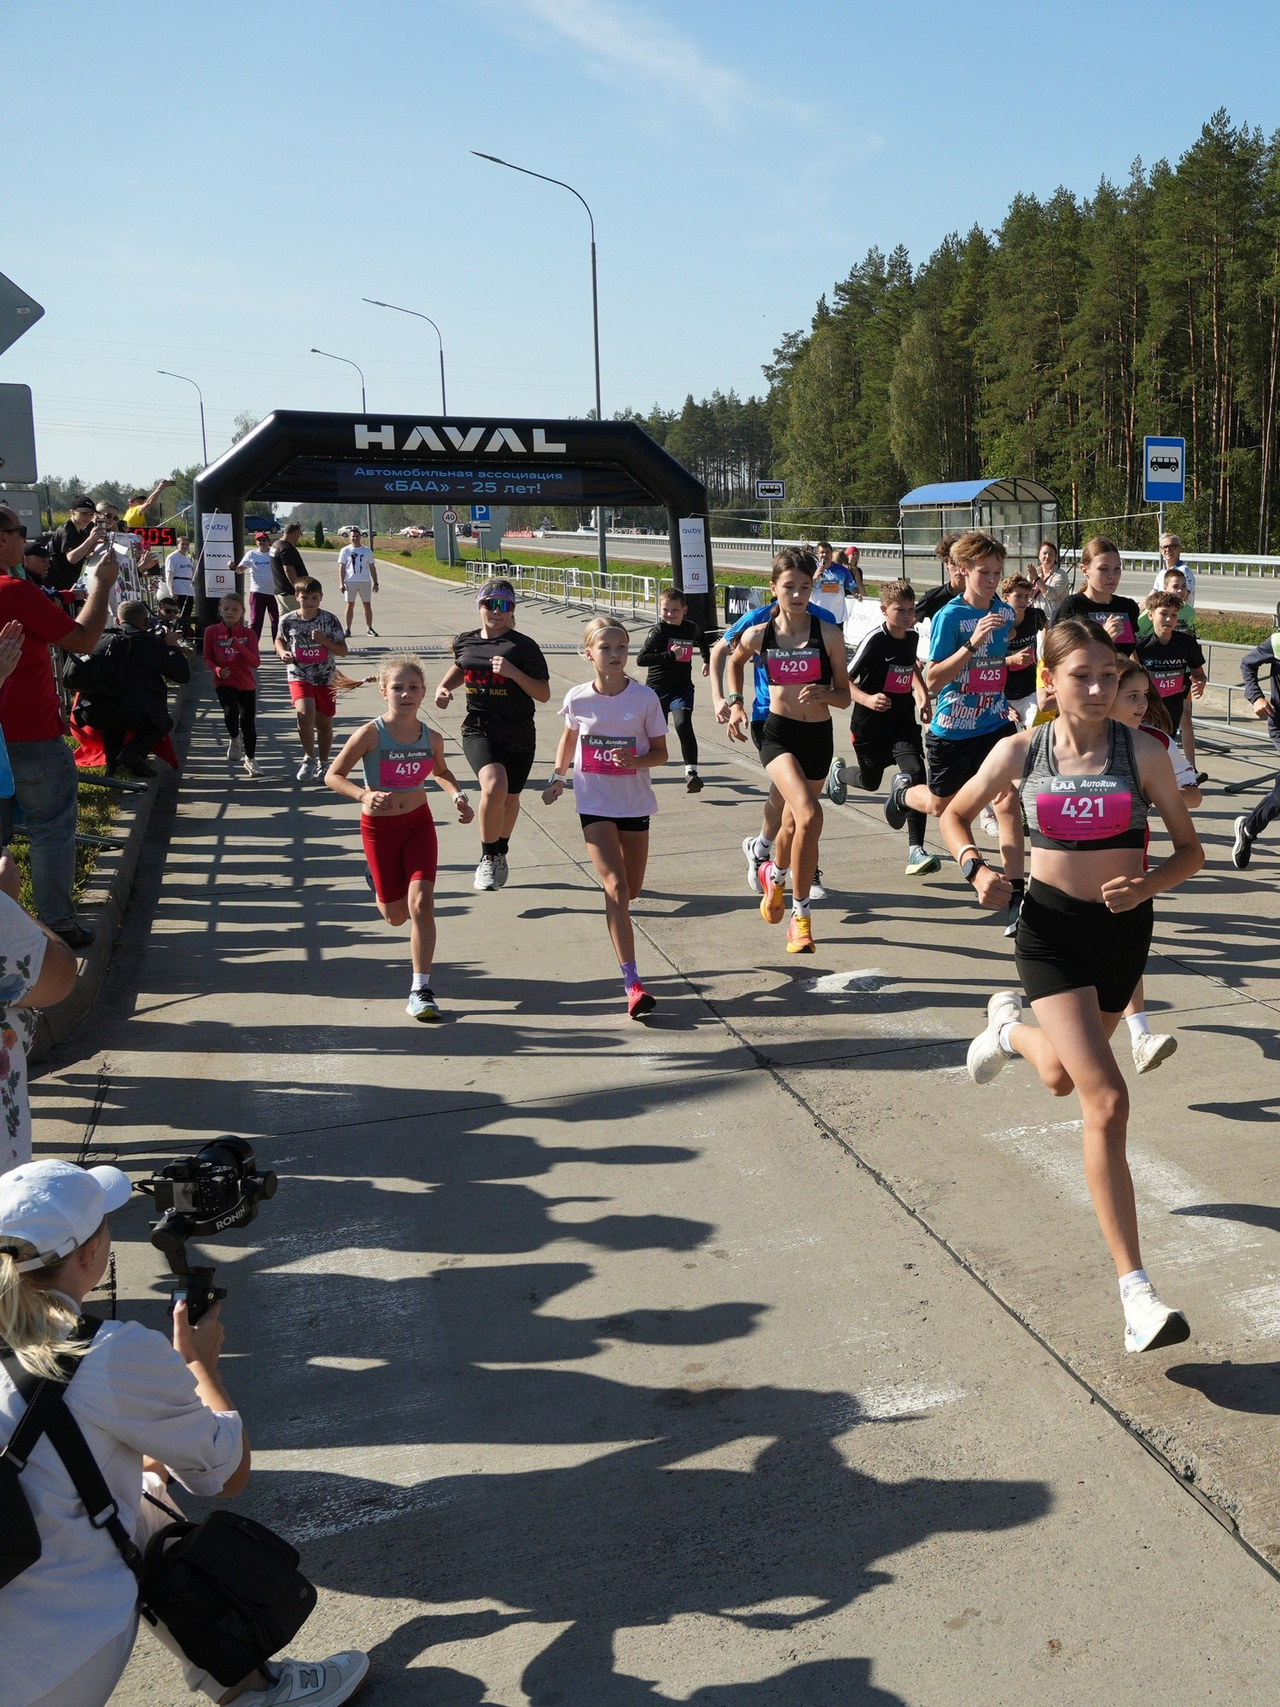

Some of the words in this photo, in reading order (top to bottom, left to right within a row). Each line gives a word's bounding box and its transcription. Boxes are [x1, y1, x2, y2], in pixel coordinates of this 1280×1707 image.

[354, 424, 567, 453] HAVAL
[354, 467, 473, 478] Автомобильная
[477, 471, 563, 480] ассоциация
[384, 480, 450, 493] «БАА»
[472, 481, 497, 493] 25
[503, 483, 542, 494] лет!
[475, 505, 487, 519] P
[205, 523, 229, 531] av.by
[302, 648, 321, 657] 402
[780, 660, 808, 673] 420
[895, 675, 911, 685] 401
[979, 669, 1001, 681] 425
[1159, 679, 1176, 689] 415
[489, 688, 508, 696] RACE
[593, 749, 613, 762] 40
[395, 762, 421, 775] 419
[1060, 797, 1104, 818] 421
[215, 1204, 246, 1231] RONIN
